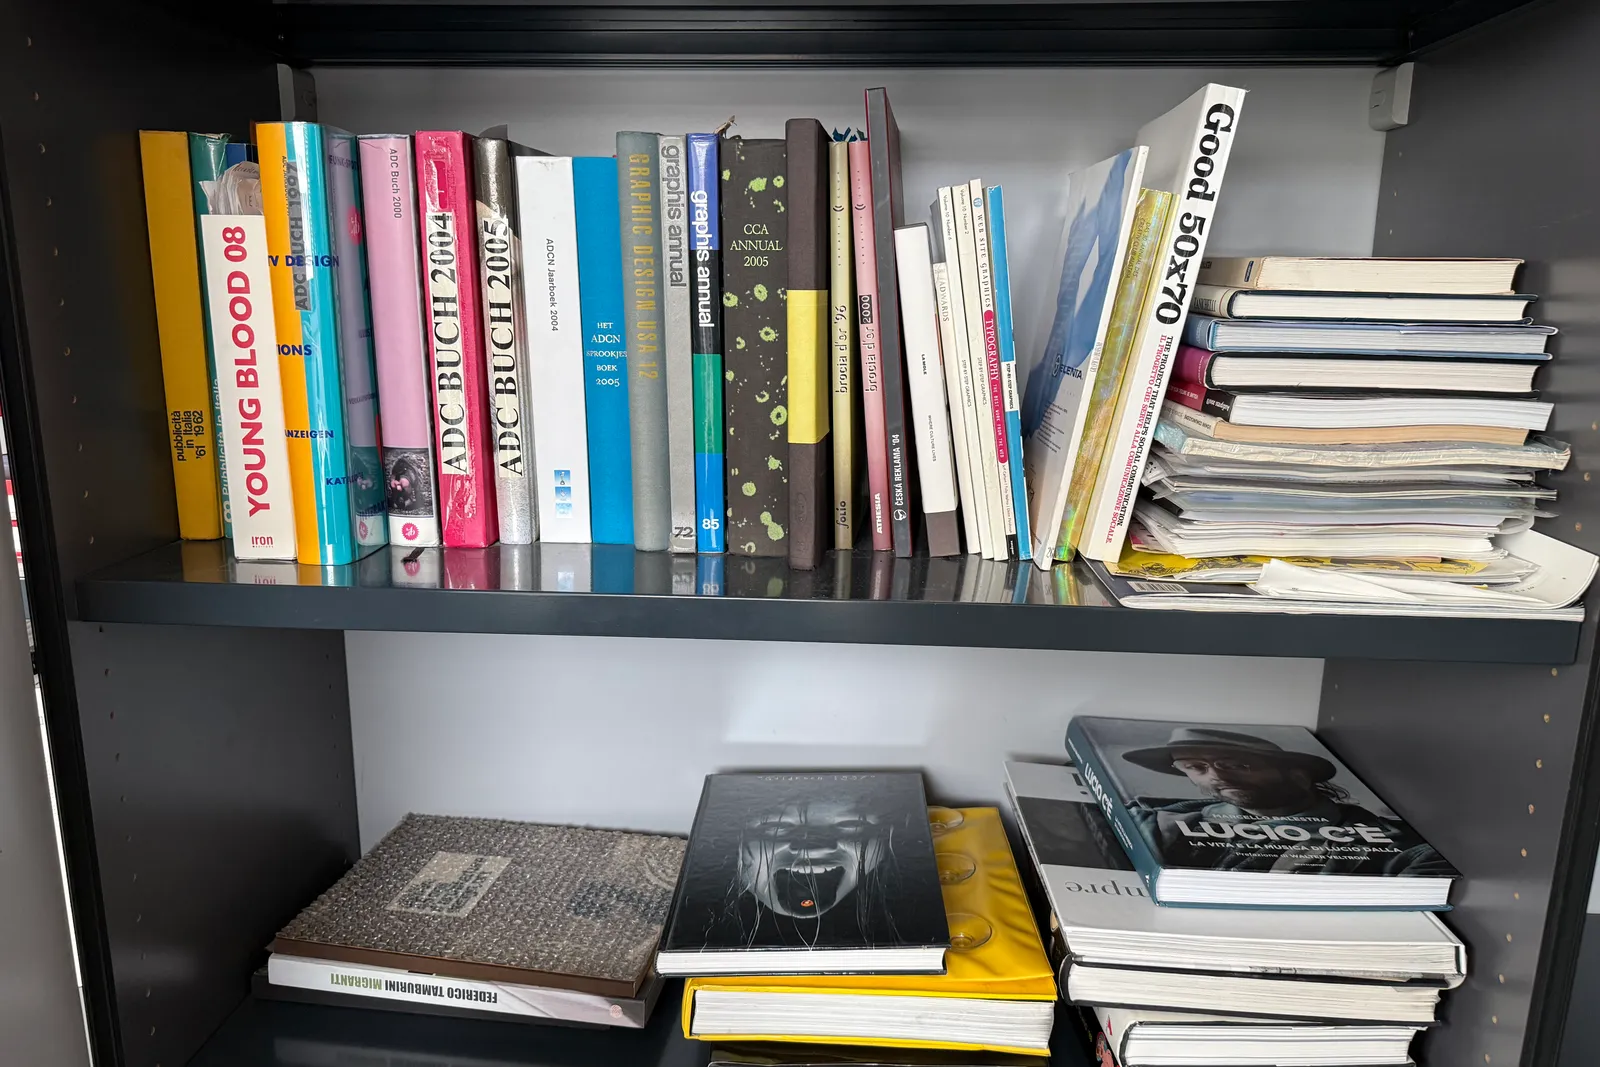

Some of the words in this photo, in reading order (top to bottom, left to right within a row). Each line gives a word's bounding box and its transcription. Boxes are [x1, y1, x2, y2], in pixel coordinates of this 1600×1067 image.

[389, 148, 399, 169] ADC
[1187, 102, 1235, 201] Good
[287, 161, 303, 209] 1997
[391, 171, 401, 194] Buch
[628, 153, 653, 235] GRAPHIC
[661, 145, 685, 220] graphis
[392, 196, 402, 219] 2000
[690, 190, 713, 262] graphis
[743, 223, 769, 235] CCA
[976, 214, 984, 233] WEB
[222, 226, 248, 263] 08
[428, 213, 456, 284] 2004
[483, 219, 511, 290] 2005
[546, 238, 555, 266] ADCN
[667, 224, 687, 287] annual
[730, 239, 783, 251] ANNUAL
[979, 237, 987, 258] SITE
[285, 255, 340, 268] DESIGN
[743, 255, 769, 267] 2005
[1155, 212, 1206, 325] 50x70
[547, 267, 557, 307] Jaarboek
[633, 245, 656, 310] DESIGN
[292, 272, 311, 311] ADC
[696, 265, 715, 328] annual
[550, 309, 559, 332] 2004
[834, 305, 847, 324] '96
[861, 294, 872, 324] 2000
[226, 270, 259, 388] BLOOD
[590, 334, 621, 344] ADCN
[636, 320, 657, 353] USA
[1159, 334, 1168, 343] IL
[433, 294, 463, 393] BUCH
[489, 300, 517, 396] BUCH
[586, 350, 628, 359] SPROOKJES
[985, 318, 999, 381] TYPOGRAPHY
[1163, 336, 1174, 353] THE
[596, 364, 618, 372] BOEK
[638, 361, 658, 380] 12
[1148, 343, 1165, 386] PROGETTO
[1155, 353, 1169, 389] PROJECT
[595, 378, 620, 388] 2005
[1143, 386, 1153, 403] CHE
[1147, 389, 1159, 410] THAT
[182, 411, 193, 435] Italia
[1136, 403, 1149, 429] SERVE
[1140, 410, 1153, 436] HELPS
[170, 411, 186, 462] pubblicità
[184, 439, 194, 448] in
[439, 403, 467, 474] ADC
[496, 407, 523, 476] ADC
[1130, 429, 1141, 449] ALLA
[239, 398, 270, 517] YOUNG
[1133, 436, 1146, 466] SOCIAL
[892, 447, 902, 482] REKLAMA
[1114, 449, 1136, 512] COMUNICAZIONE
[894, 483, 904, 506] ČESKÁ
[702, 518, 720, 530] 85
[874, 492, 883, 534] ATHESIA
[251, 536, 273, 546] iron
[674, 526, 694, 538] 72
[1084, 762, 1103, 801] LUCIO
[1212, 813, 1270, 822] MARCELLO
[1271, 815, 1329, 823] BALESTRA
[1175, 820, 1311, 841] LUCIO
[1318, 823, 1394, 844] C'È
[1207, 841, 1234, 849] VITA
[330, 972, 382, 990] MIGRANTI
[384, 979, 444, 998] TAMBURINI
[447, 987, 498, 1004] FEDERICO
